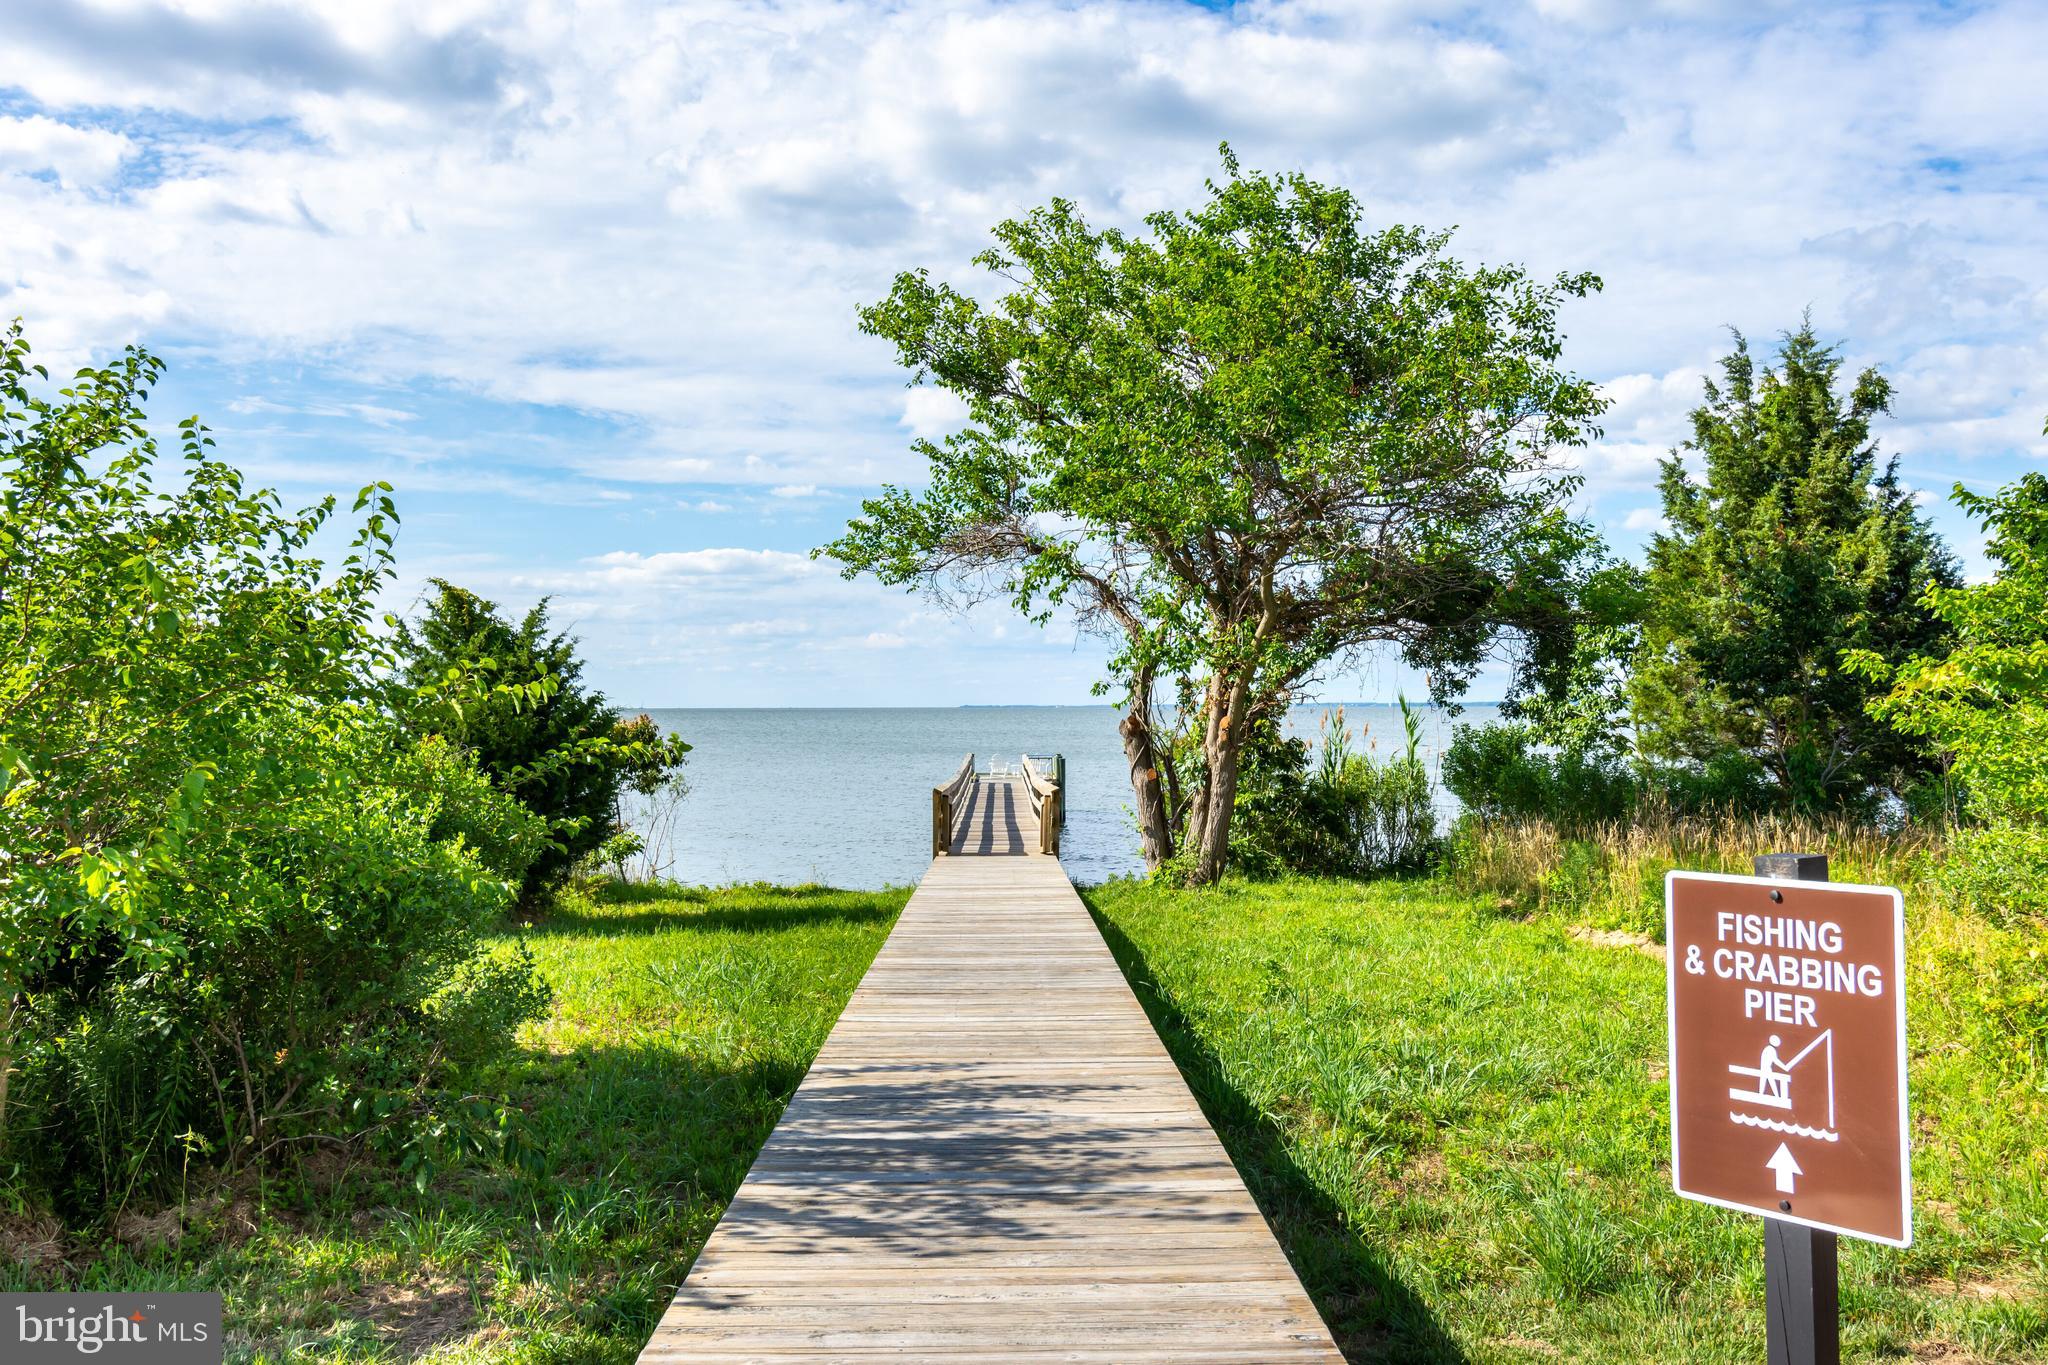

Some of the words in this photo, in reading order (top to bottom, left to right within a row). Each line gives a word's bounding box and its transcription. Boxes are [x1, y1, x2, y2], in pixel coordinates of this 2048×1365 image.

[1717, 911, 1843, 954] FISHING
[1684, 944, 1706, 976] &
[1713, 948, 1883, 997] CRABBING
[1744, 988, 1818, 1028] PIER
